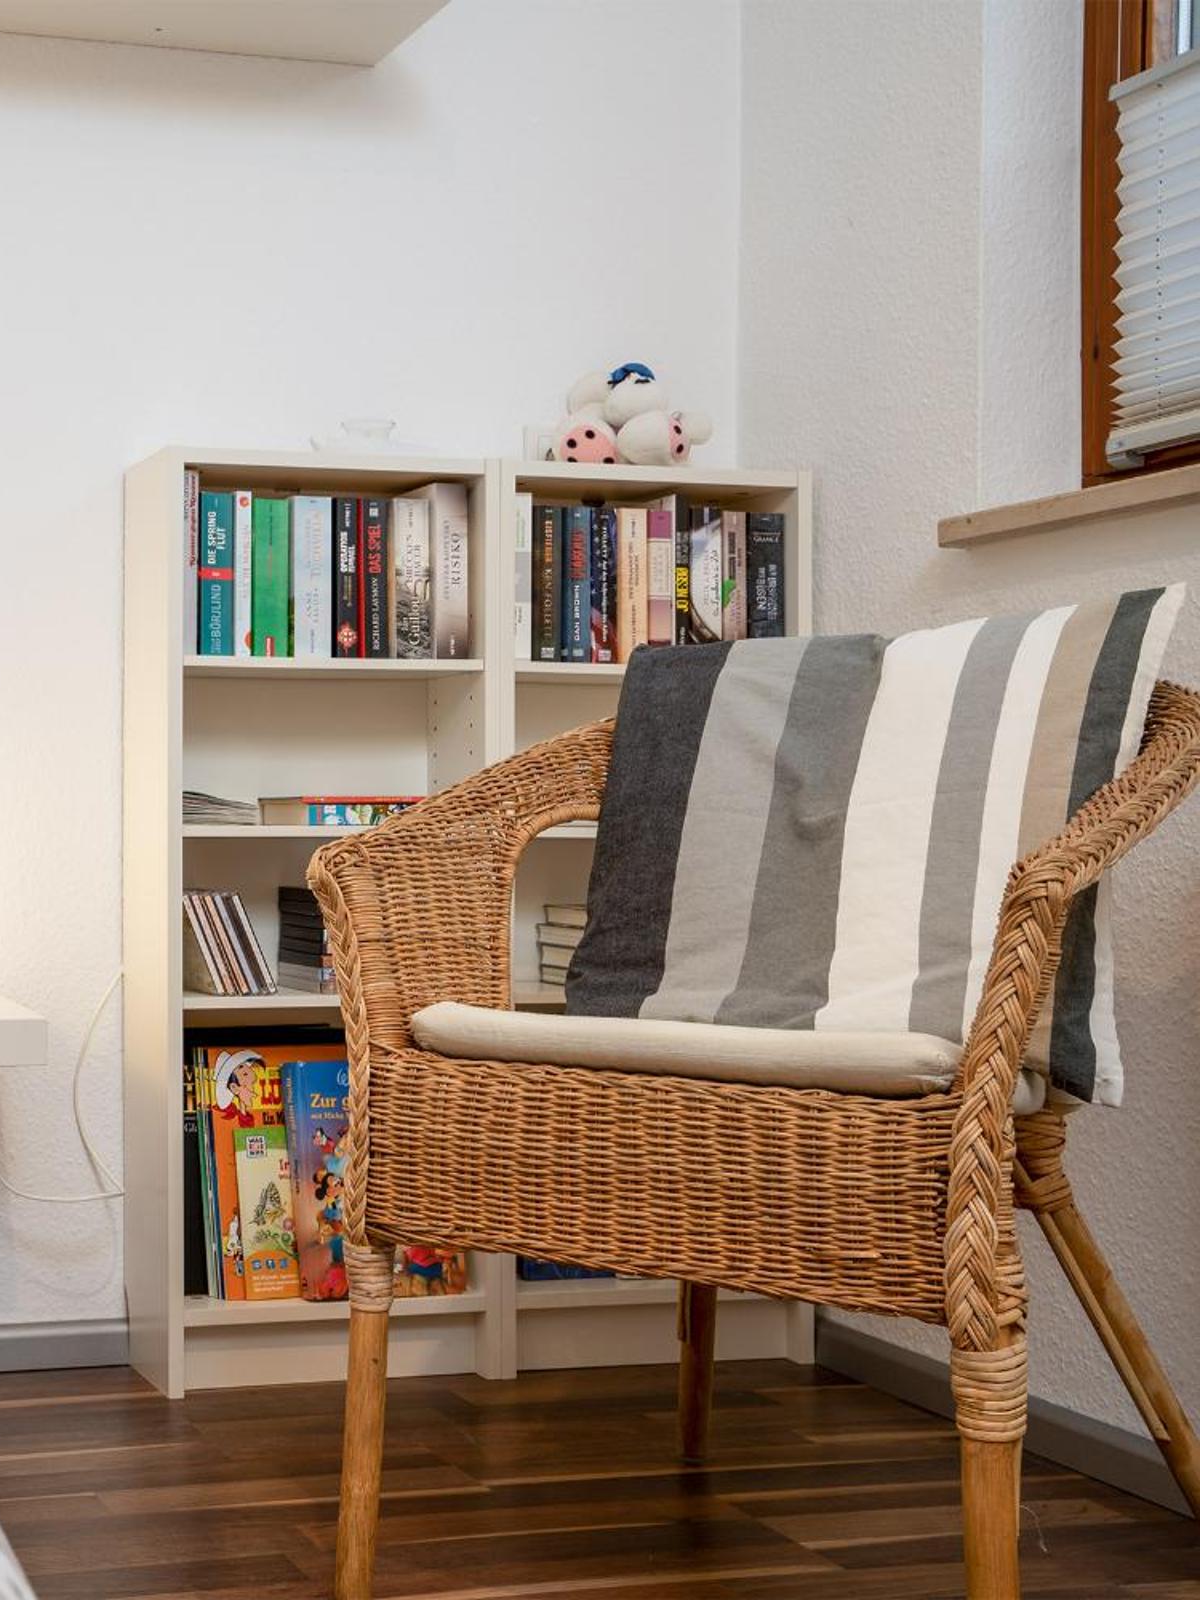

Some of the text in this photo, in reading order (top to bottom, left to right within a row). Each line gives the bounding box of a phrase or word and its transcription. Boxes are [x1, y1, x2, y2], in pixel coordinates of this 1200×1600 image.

[207, 510, 217, 547] SPRING
[216, 526, 226, 550] FLUT
[207, 549, 217, 565] DIE
[368, 524, 382, 574] DAS SPIEL
[450, 532, 461, 586] RISIKO
[573, 584, 581, 619] BROWN
[676, 599, 689, 613] JO
[371, 612, 381, 651] RICHARD
[406, 597, 421, 646] Guillou
[573, 621, 581, 641] DAN
[310, 1093, 337, 1108] Zur
